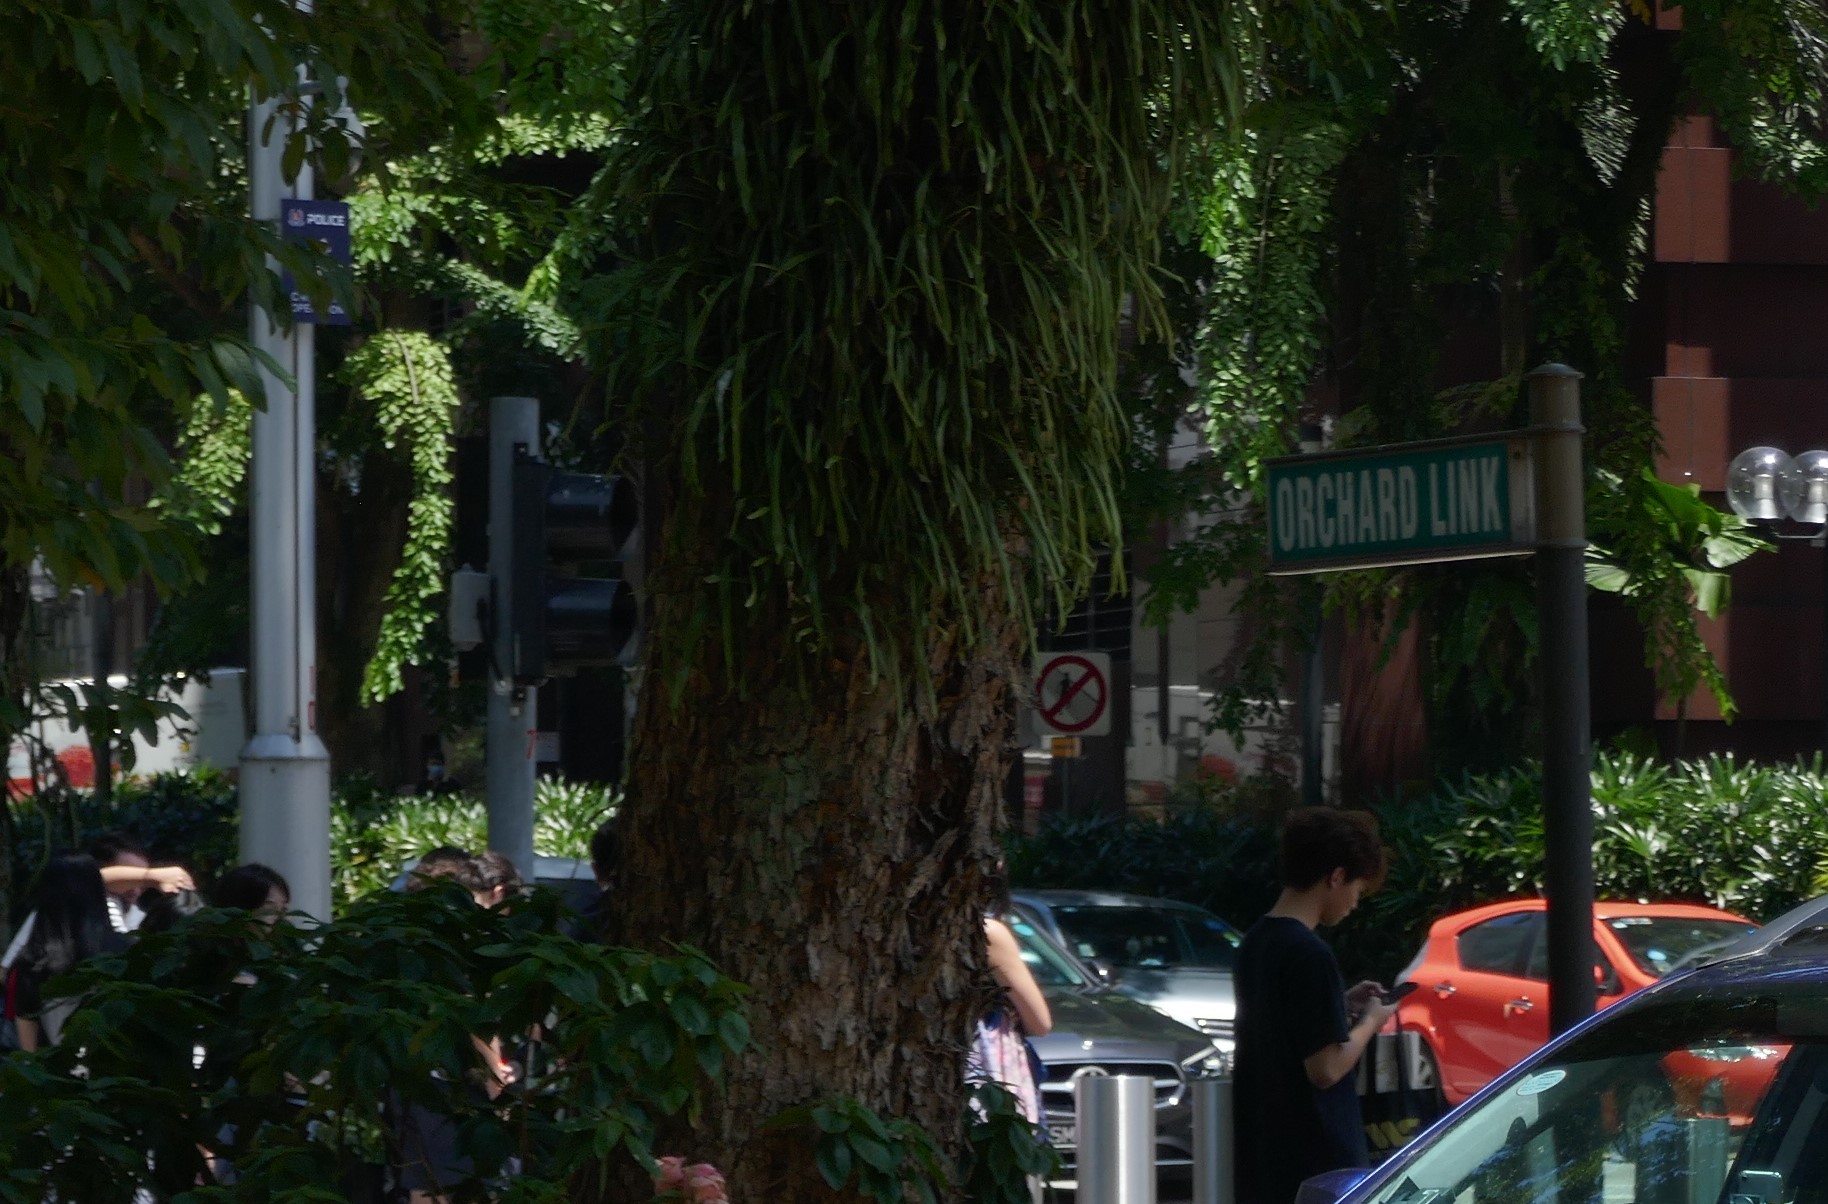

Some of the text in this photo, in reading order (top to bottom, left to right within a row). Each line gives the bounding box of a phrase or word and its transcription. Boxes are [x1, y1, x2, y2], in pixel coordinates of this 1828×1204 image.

[306, 213, 345, 227] POLICE
[1276, 456, 1503, 552] ORCHARD LINK
